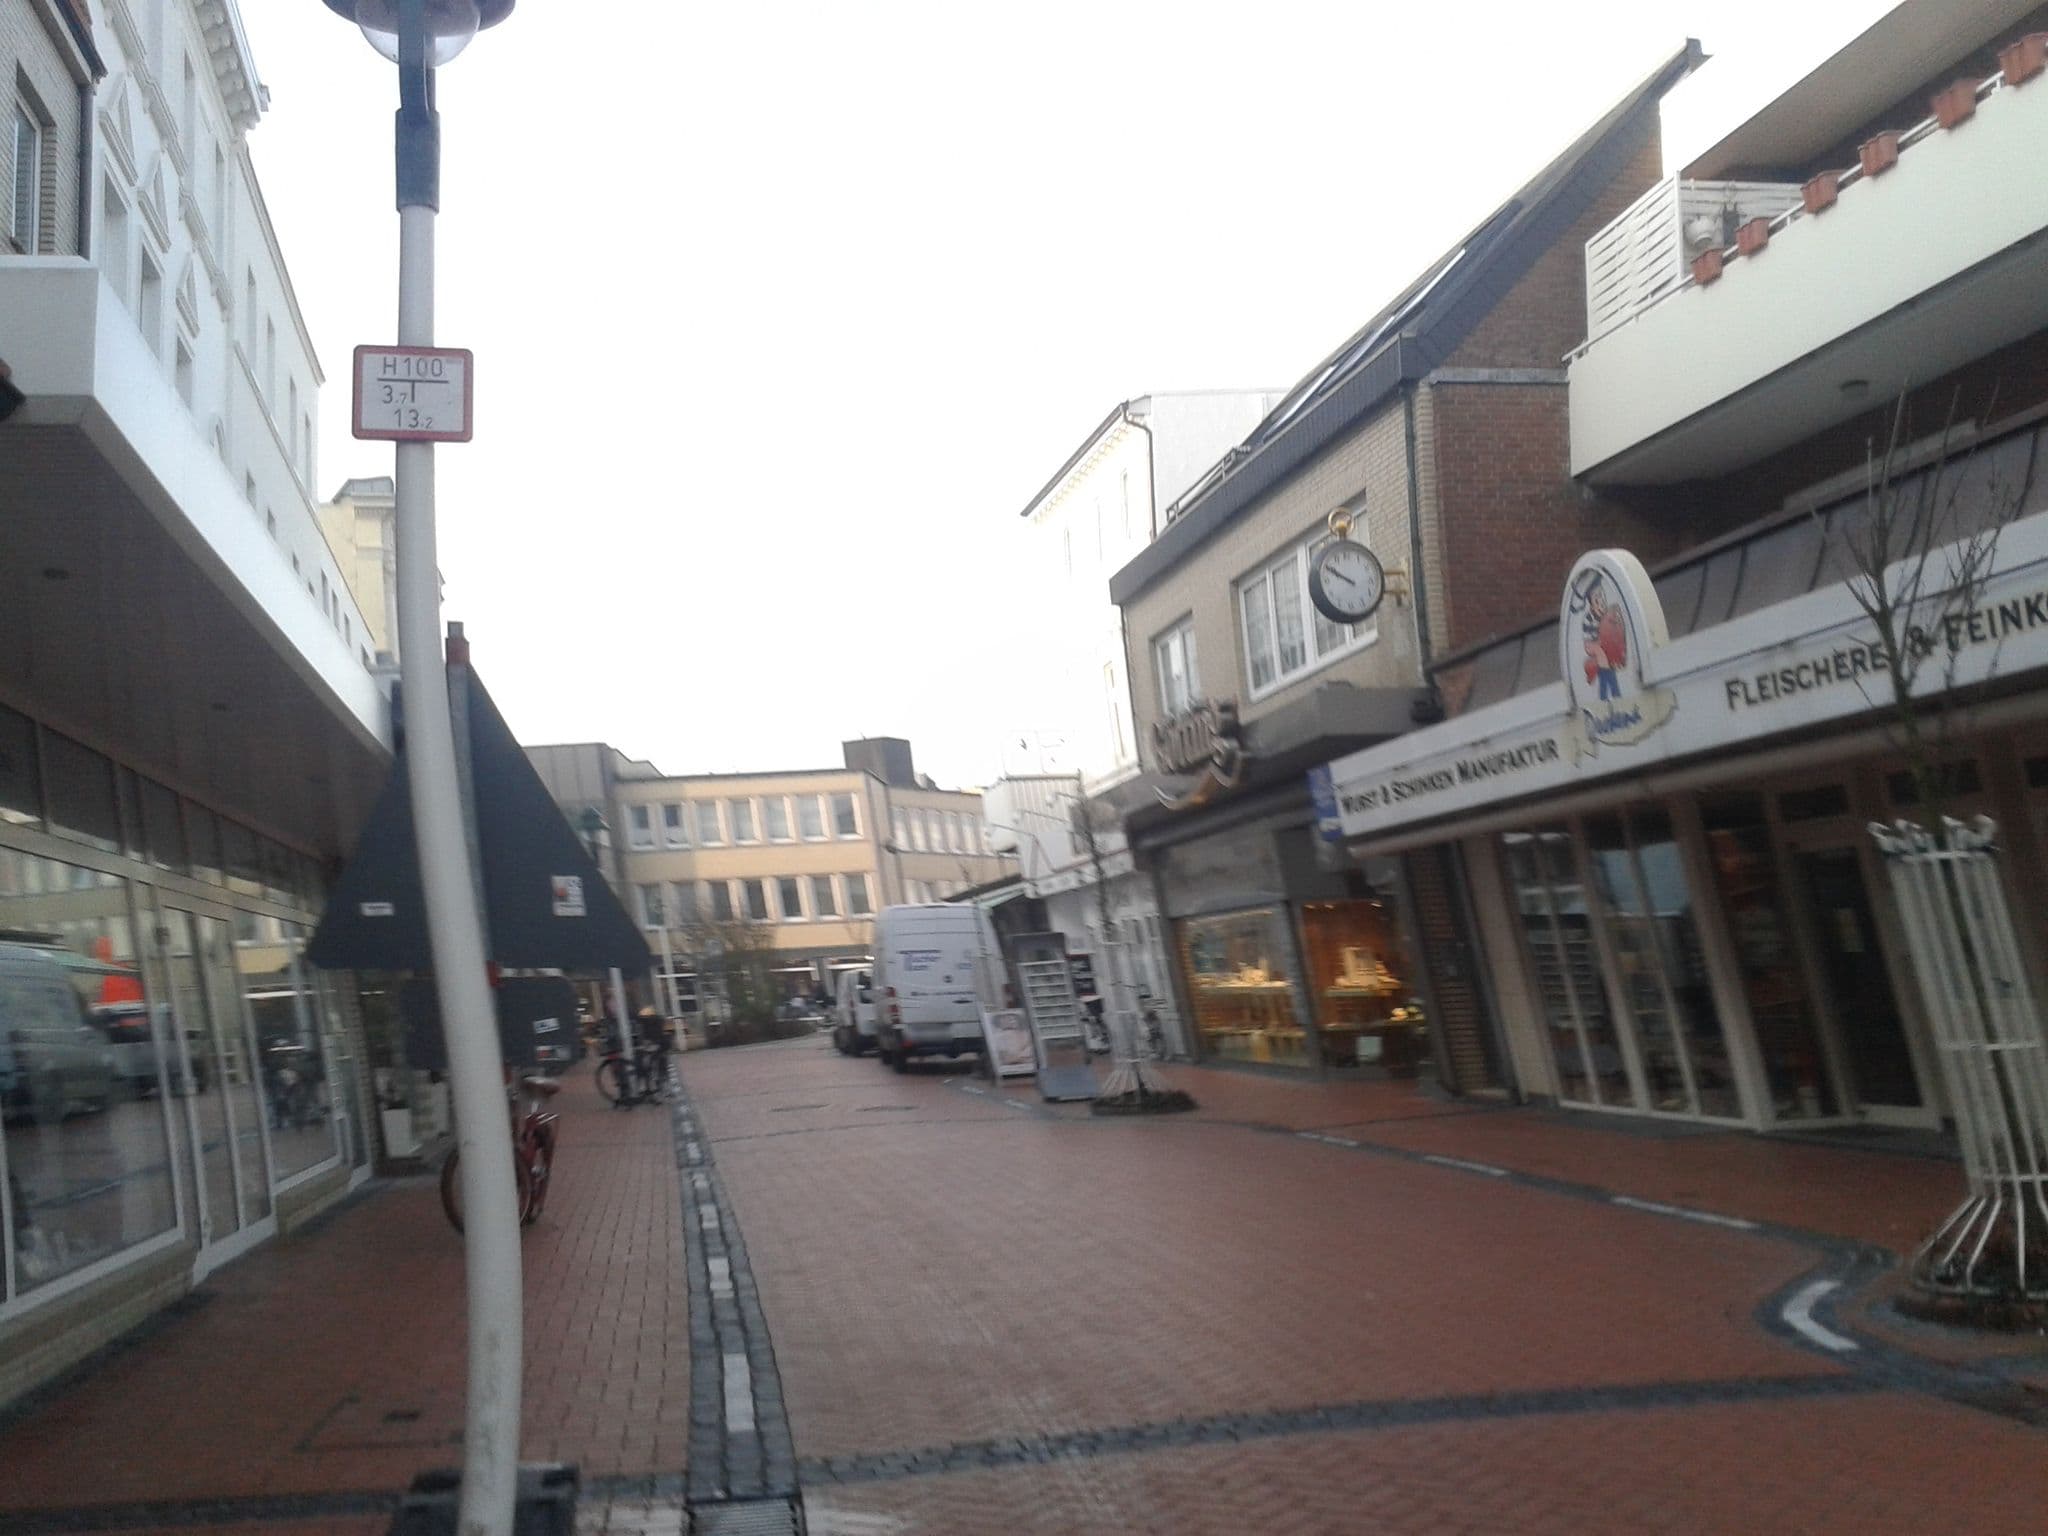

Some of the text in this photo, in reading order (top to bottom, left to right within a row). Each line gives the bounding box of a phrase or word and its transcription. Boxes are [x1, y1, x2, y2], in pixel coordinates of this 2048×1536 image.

[382, 356, 443, 377] H100
[1724, 641, 1896, 711] FLEISCHERE
[1941, 590, 2048, 652] FEINK
[1455, 738, 1560, 783] MANUFAKTUR
